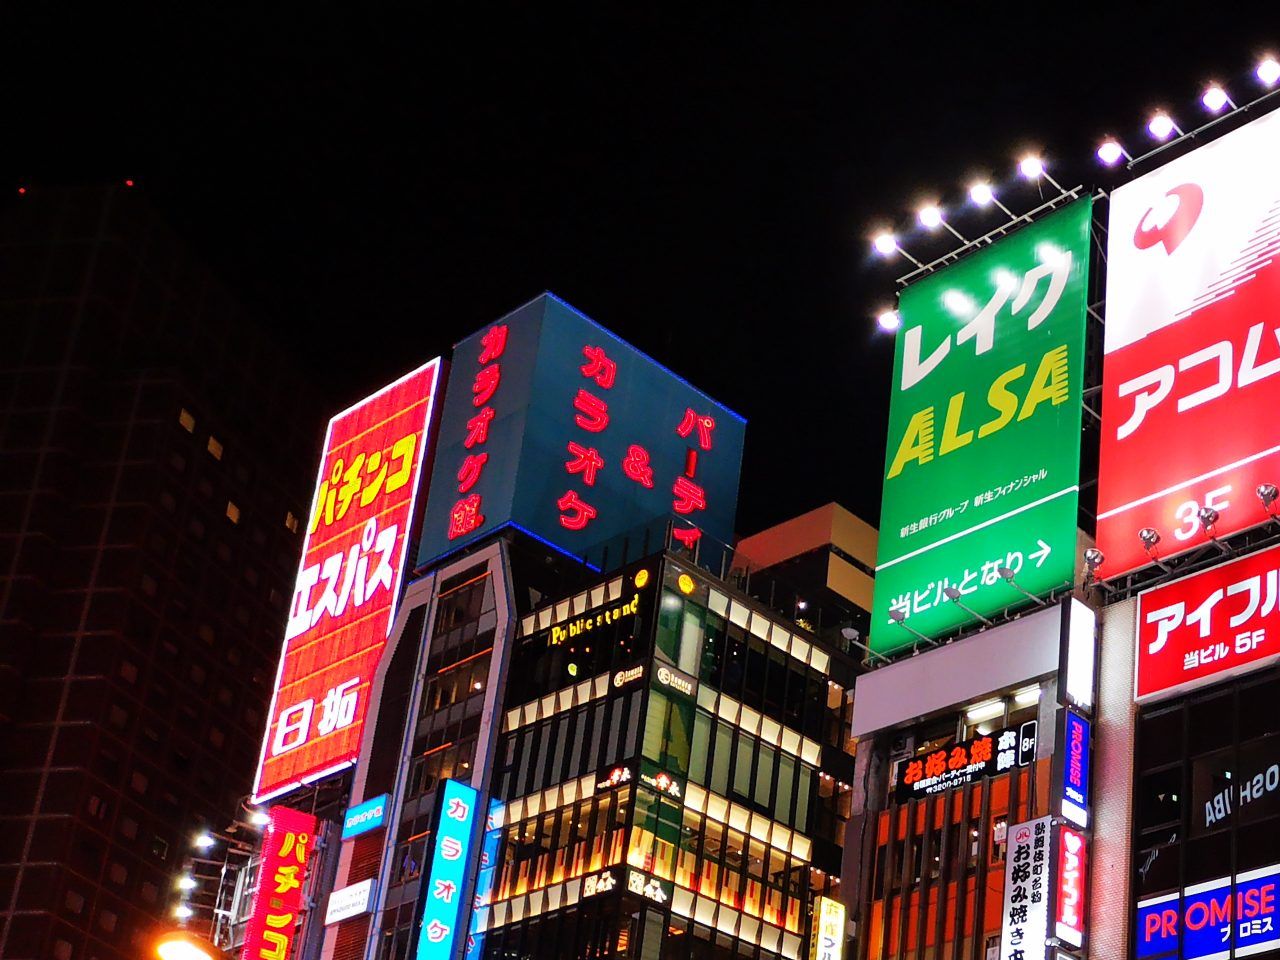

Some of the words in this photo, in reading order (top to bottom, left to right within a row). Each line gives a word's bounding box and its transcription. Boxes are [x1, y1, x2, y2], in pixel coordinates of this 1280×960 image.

[901, 251, 1072, 392] レイク
[448, 324, 508, 540] カラオケ館
[558, 345, 617, 531] カラオケ
[887, 345, 1068, 479] ALSA
[311, 432, 417, 532] パチンコ
[623, 445, 653, 488] &
[900, 500, 968, 538] 新生銀行グループ
[974, 469, 1047, 507] 新生フィナンシャル
[1175, 485, 1232, 540] 3F
[289, 518, 396, 636] エスパス
[888, 550, 1023, 623] 当ビルとなり
[1183, 643, 1229, 670] 当ビル
[1236, 629, 1265, 654] 5F
[904, 737, 992, 784] お好み焼
[1022, 735, 1035, 751] 8F
[1070, 721, 1083, 786] PROMISE
[1145, 885, 1274, 942] PROMISE
